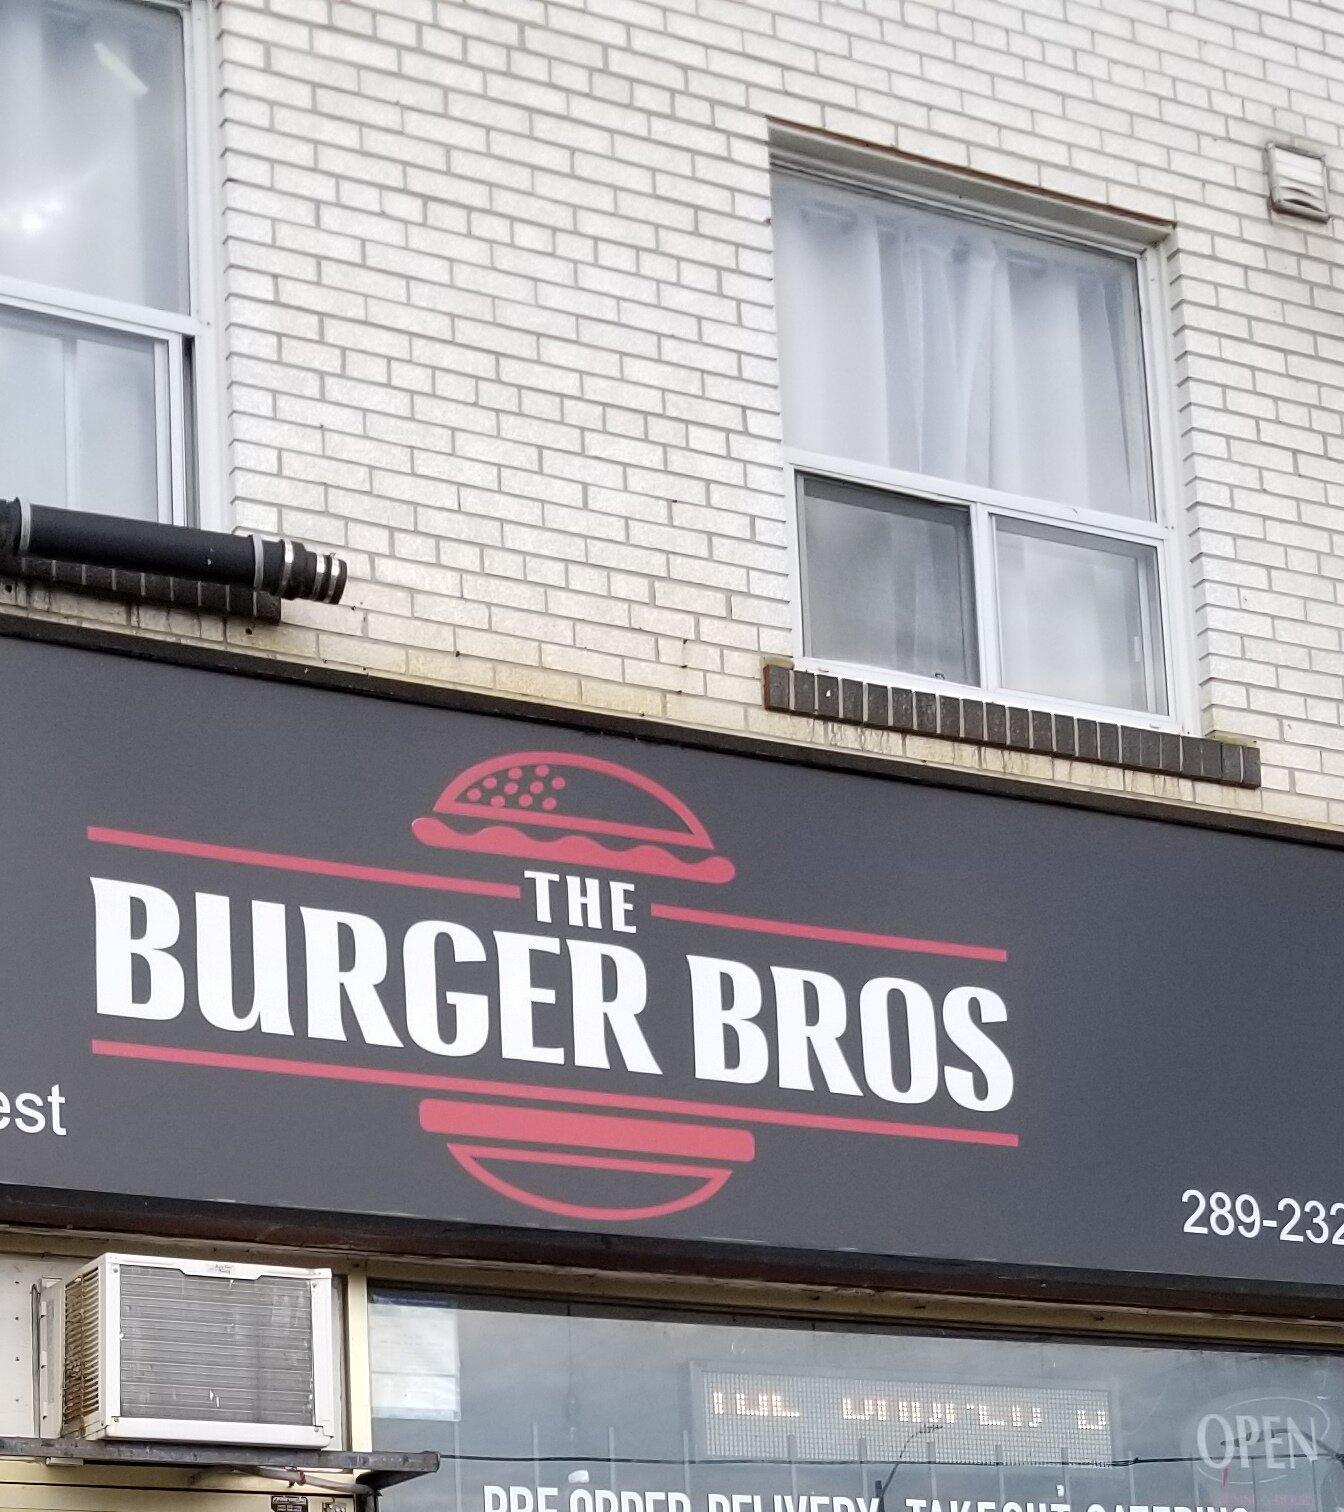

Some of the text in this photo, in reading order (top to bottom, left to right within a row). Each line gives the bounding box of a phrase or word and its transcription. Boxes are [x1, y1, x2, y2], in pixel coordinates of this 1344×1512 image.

[523, 870, 641, 934] THE
[89, 876, 1014, 1113] BURGER BROS
[1197, 1412, 1319, 1470] OPEN
